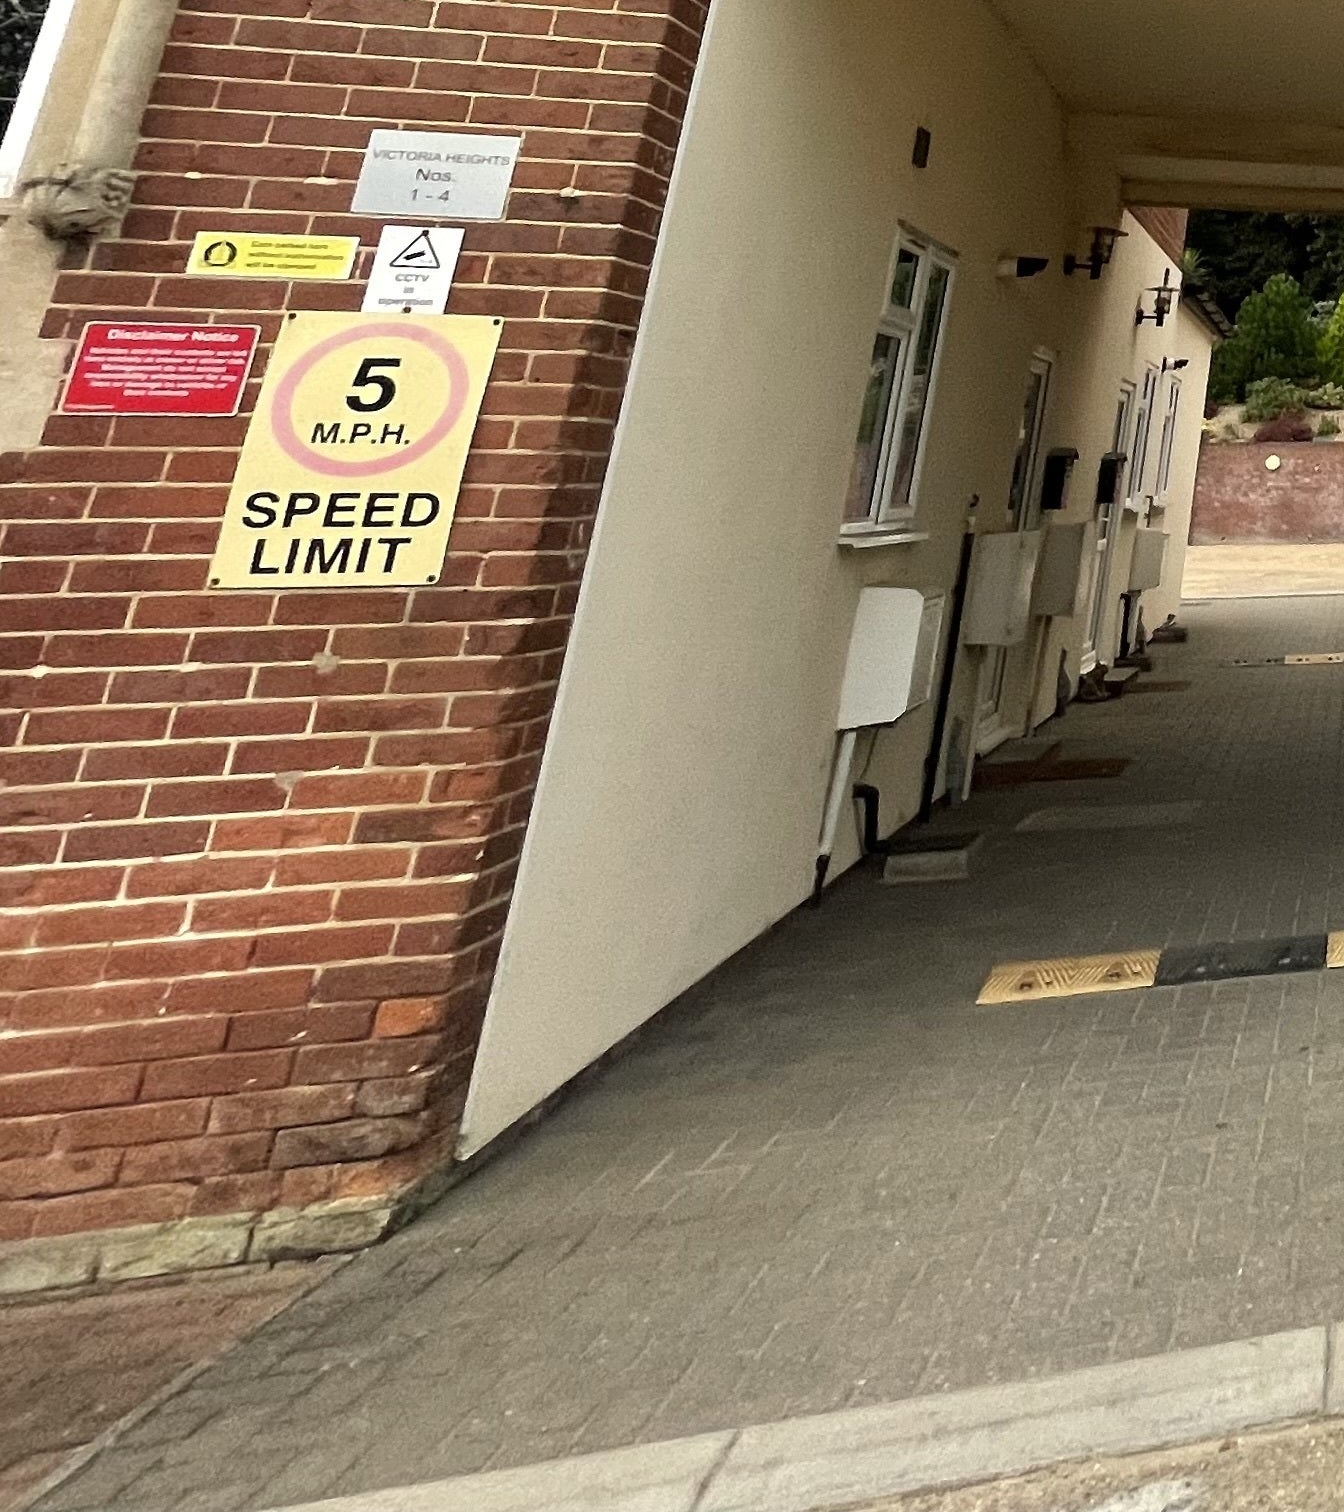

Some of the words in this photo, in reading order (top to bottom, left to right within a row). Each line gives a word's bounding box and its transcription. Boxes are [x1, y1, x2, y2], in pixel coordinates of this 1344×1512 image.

[373, 149, 442, 162] VICTORIA
[445, 153, 511, 166] HEIGHTS
[411, 188, 418, 201] 1
[438, 190, 450, 202] 4
[395, 273, 430, 283] CCTV
[346, 358, 402, 413] 5
[311, 422, 411, 445] M.P.H.
[242, 492, 440, 529] SPEED
[249, 537, 412, 575] LIMIT
